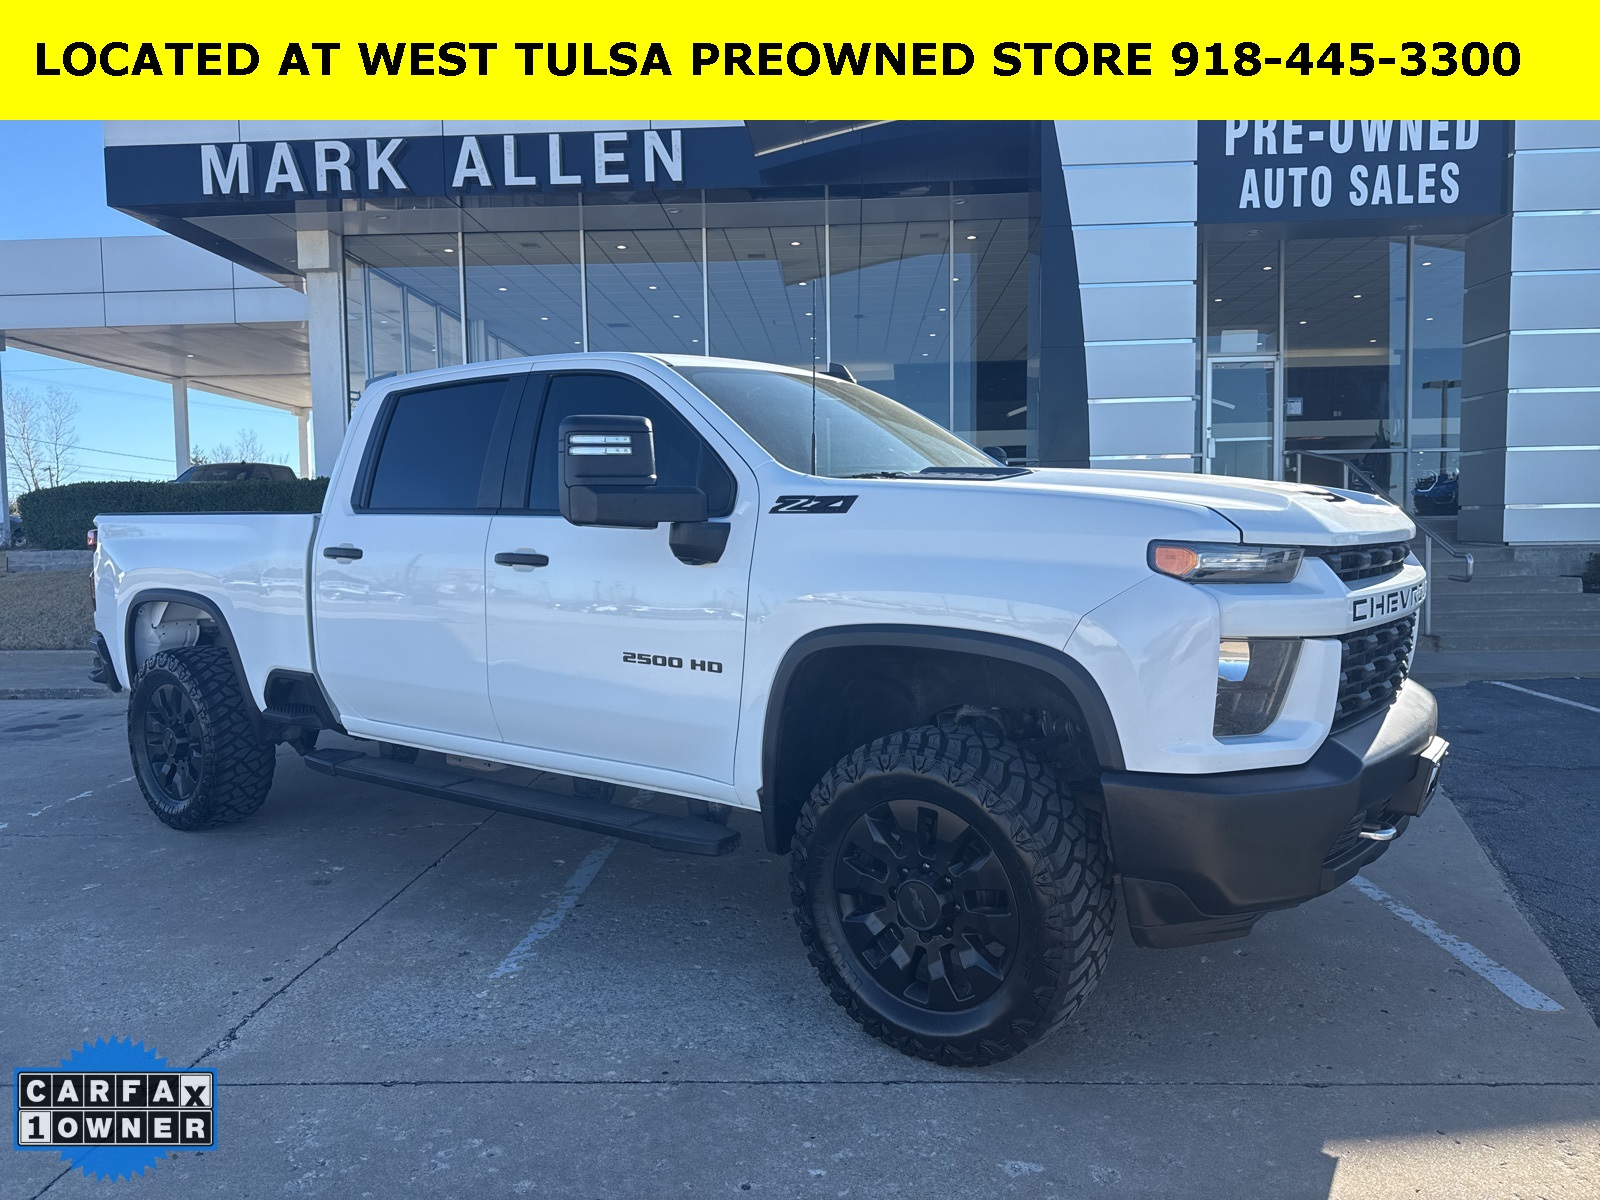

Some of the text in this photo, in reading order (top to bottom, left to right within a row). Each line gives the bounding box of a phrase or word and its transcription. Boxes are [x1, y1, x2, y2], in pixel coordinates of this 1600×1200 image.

[1225, 120, 1480, 155] PRE-OWNED
[201, 130, 684, 196] MARK ALLEN
[1238, 161, 1460, 209] AUTO SALES
[622, 651, 723, 674] 2500 HD
